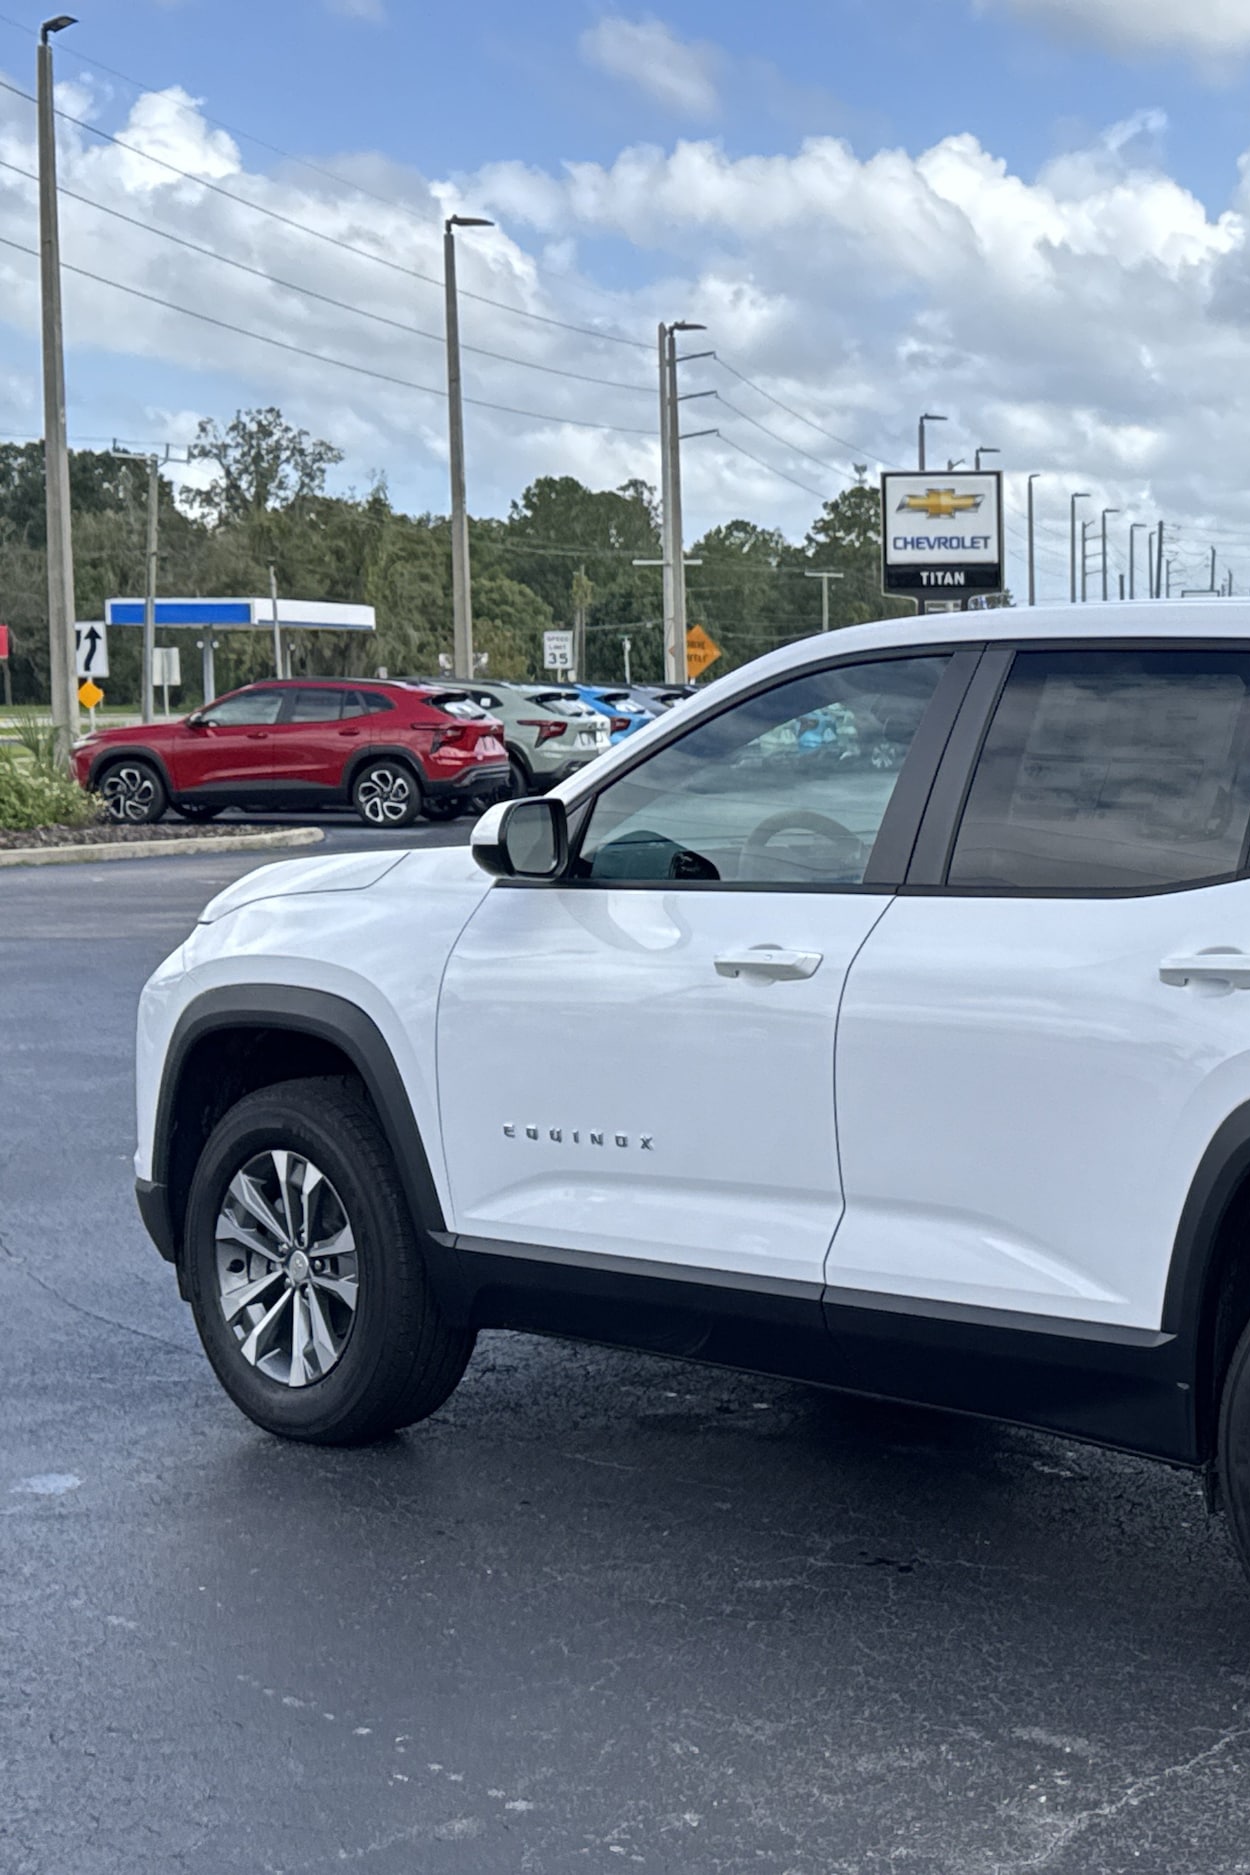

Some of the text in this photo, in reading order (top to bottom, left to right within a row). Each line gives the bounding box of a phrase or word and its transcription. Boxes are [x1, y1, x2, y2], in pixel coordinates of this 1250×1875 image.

[893, 535, 991, 551] CHEVROLET
[920, 571, 966, 586] TITAN
[548, 652, 569, 665] 35
[502, 1121, 654, 1151] EQUINOX
